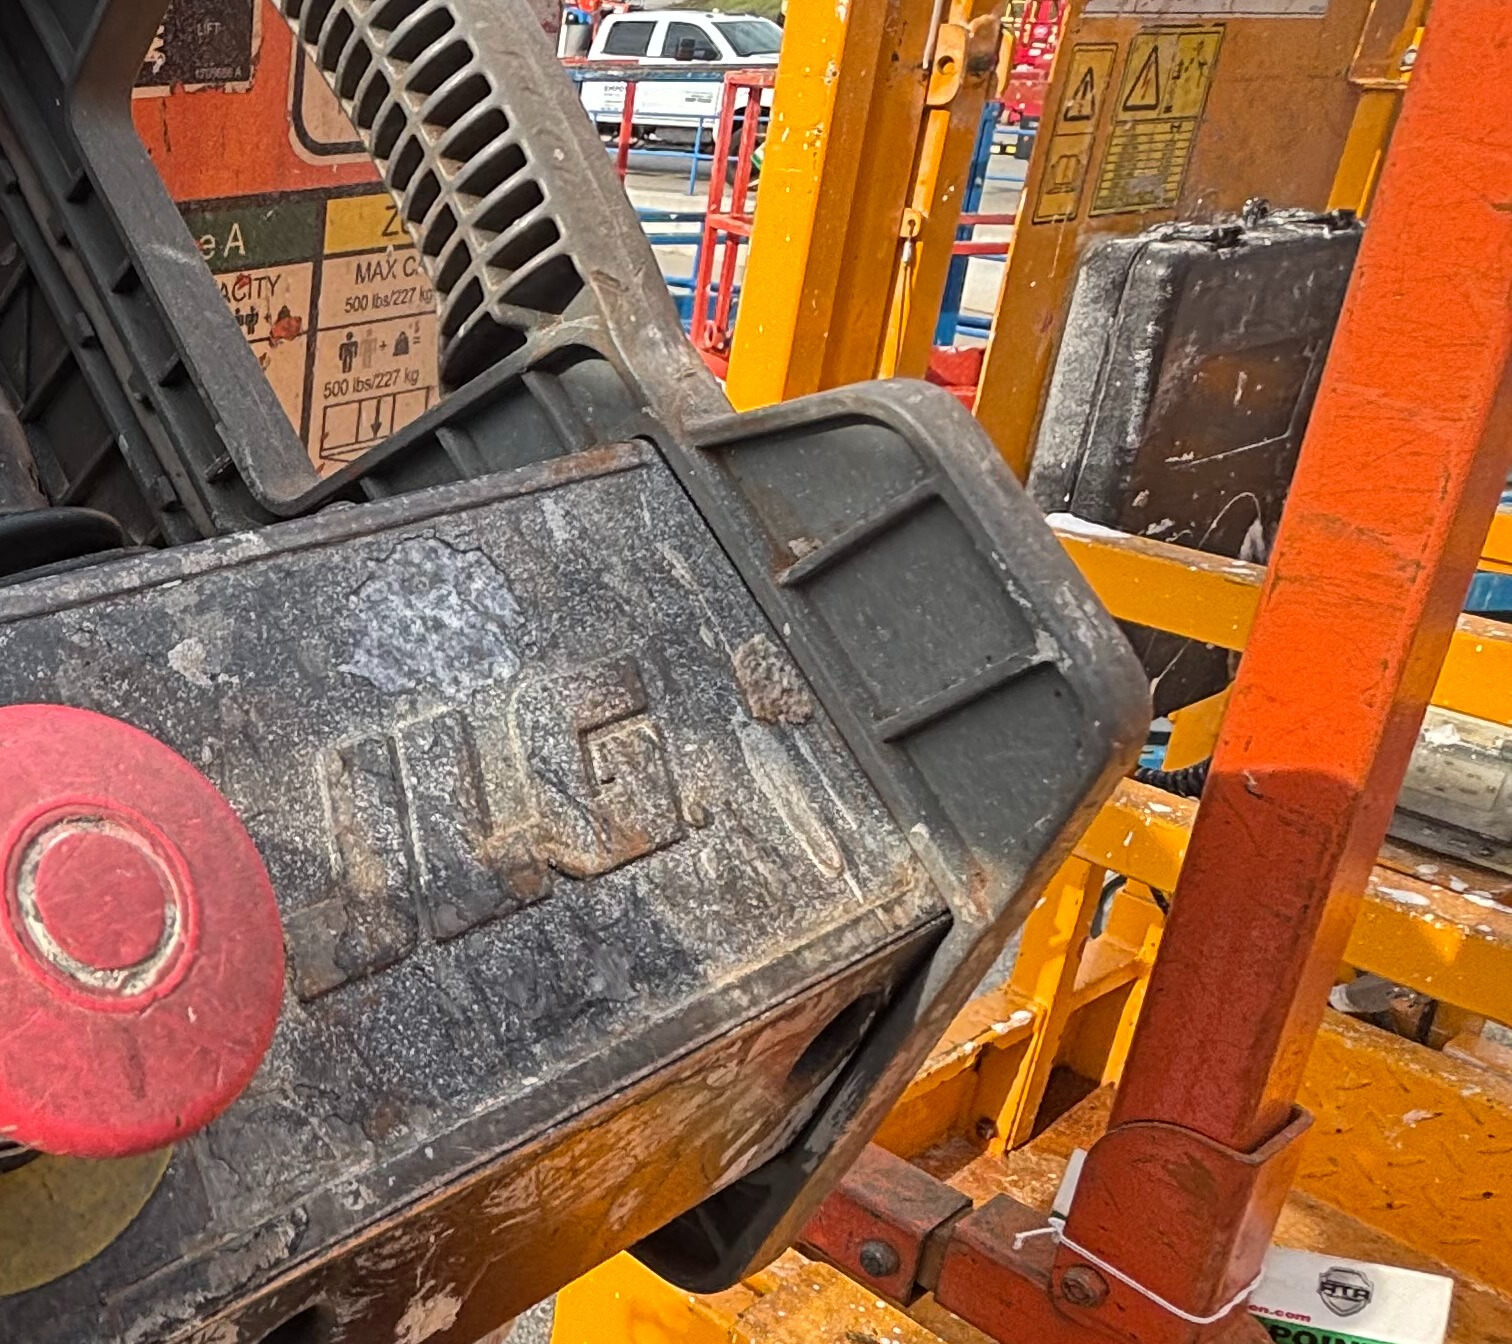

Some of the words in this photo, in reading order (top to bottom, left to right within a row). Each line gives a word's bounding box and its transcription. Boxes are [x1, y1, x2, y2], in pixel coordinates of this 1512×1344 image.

[197, 21, 222, 36] LIFT
[355, 257, 398, 286] MAX
[345, 295, 369, 314] 500
[372, 286, 417, 309] lbs/227
[323, 379, 349, 399] 500
[352, 368, 400, 394] lbs/227
[404, 367, 420, 387] kg
